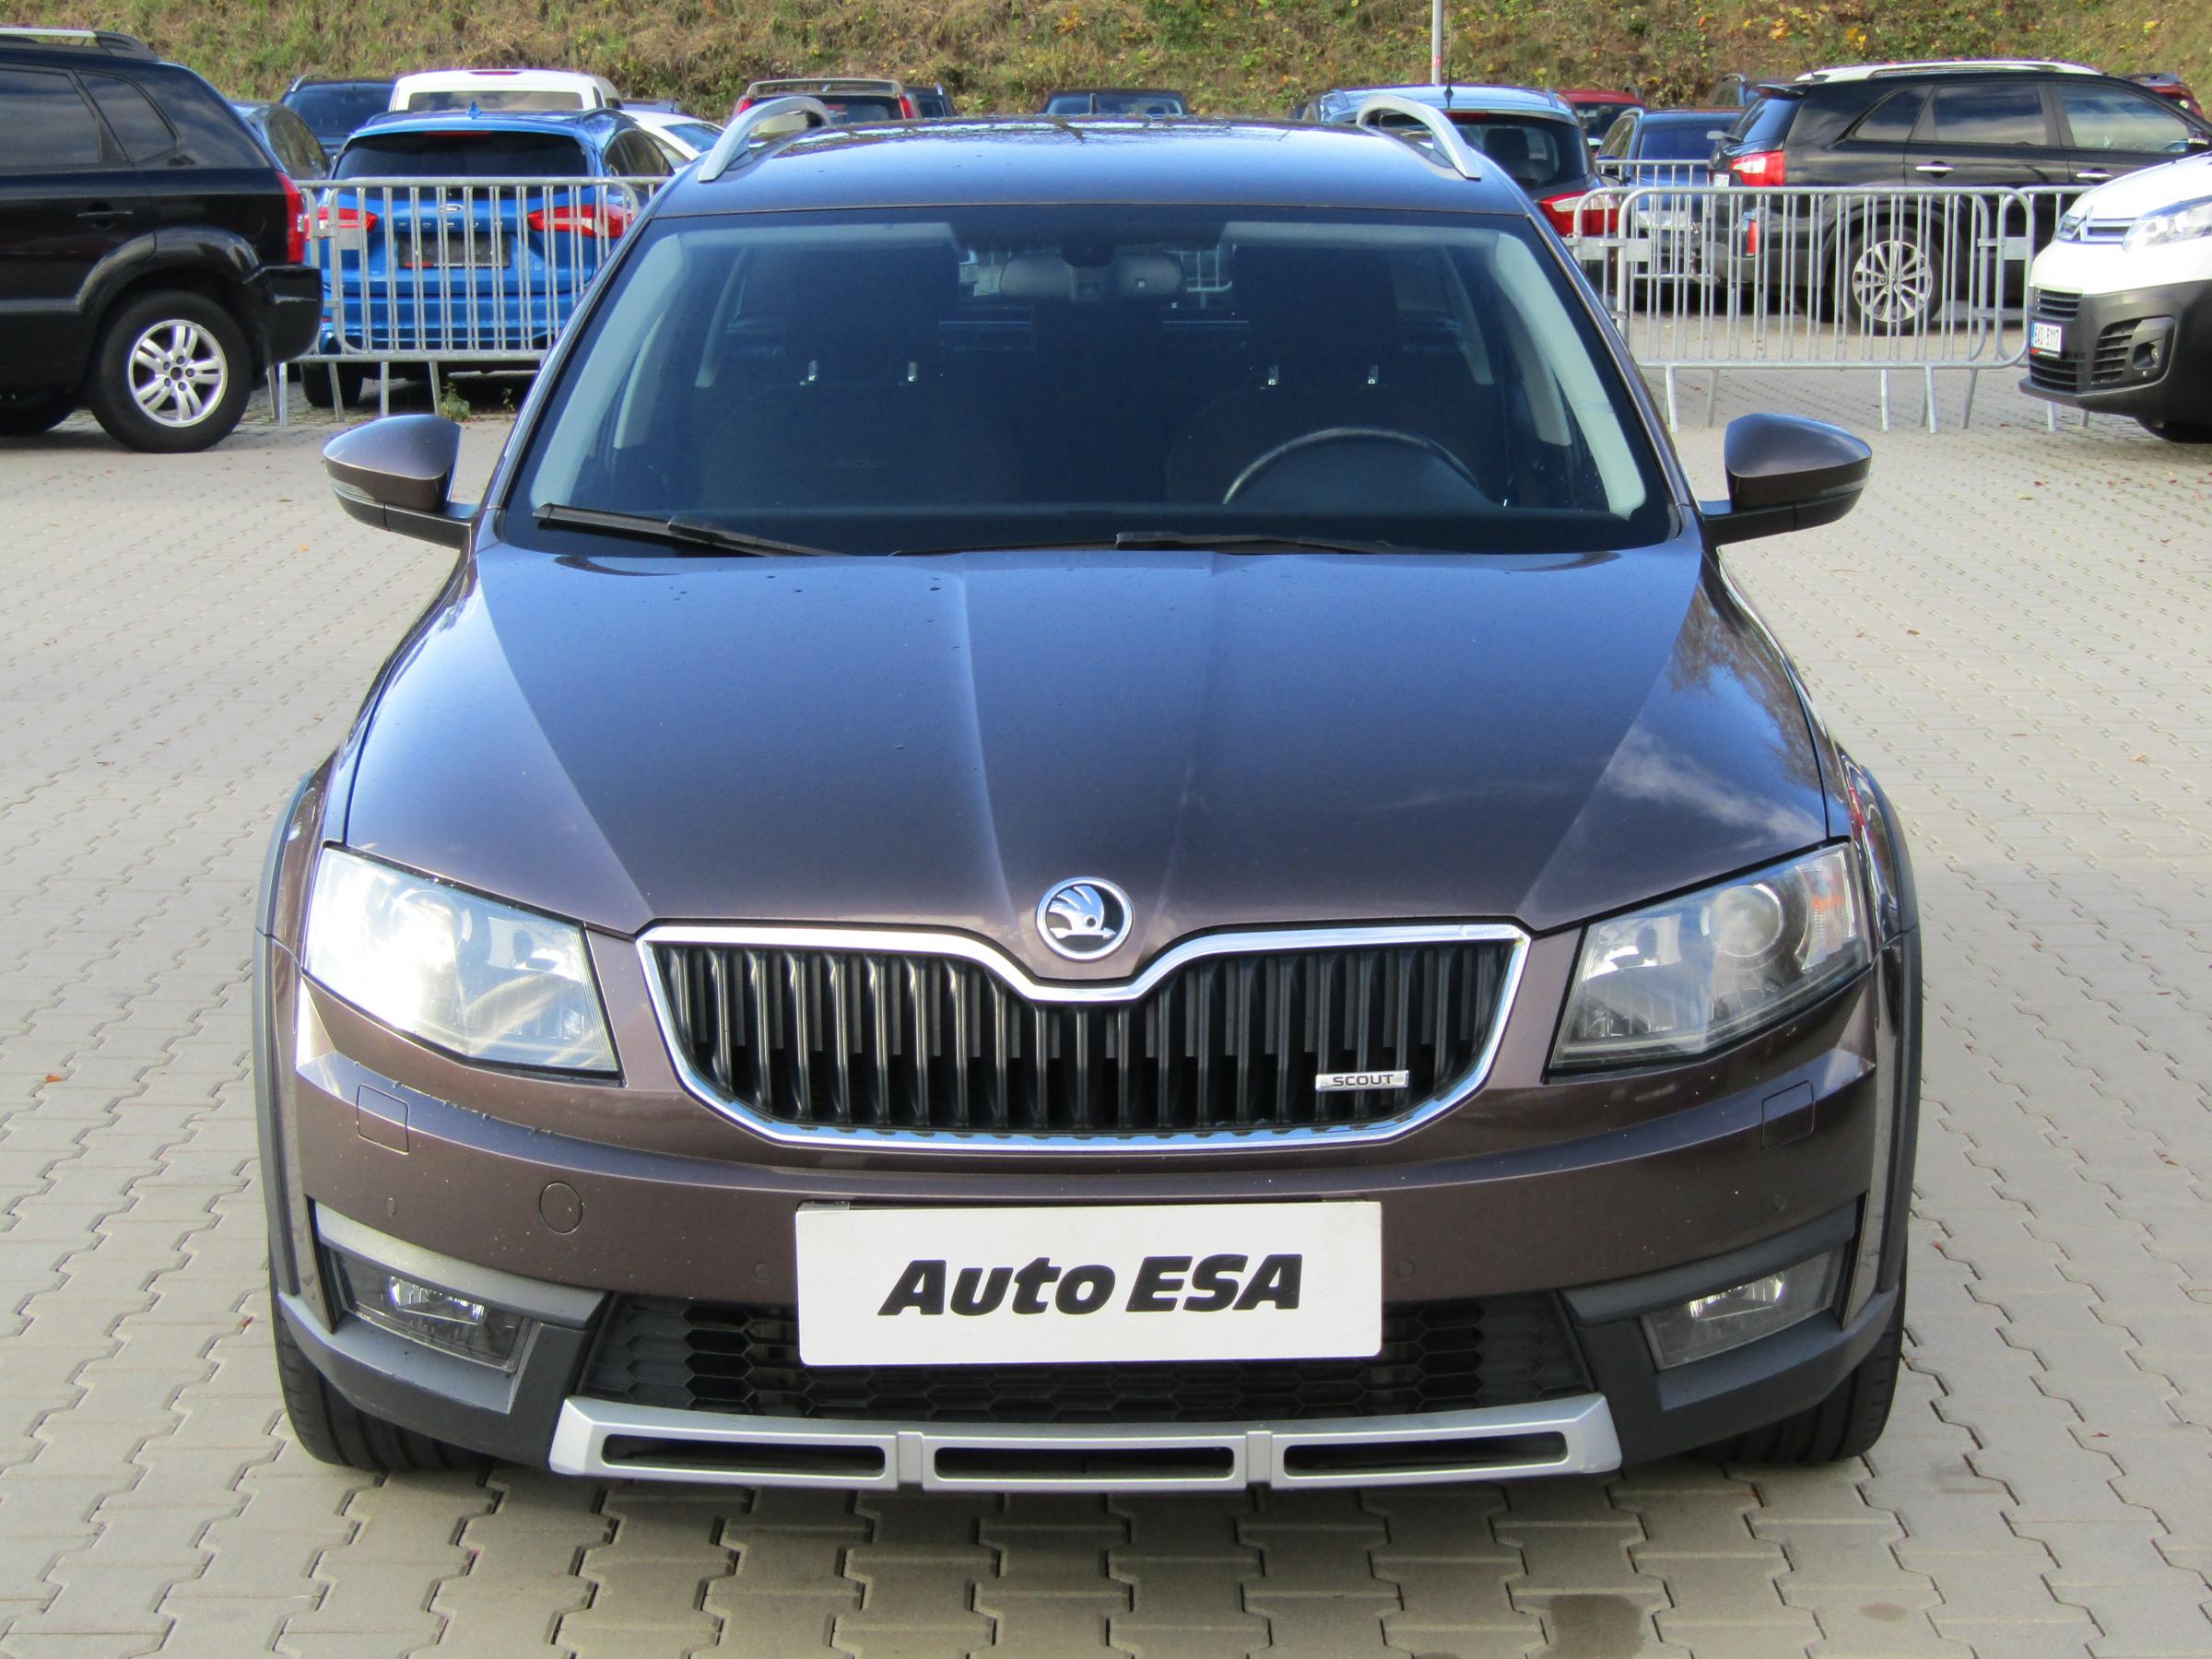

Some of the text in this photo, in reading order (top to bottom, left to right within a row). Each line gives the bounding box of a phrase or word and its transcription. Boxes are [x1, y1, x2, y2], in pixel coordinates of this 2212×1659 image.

[1333, 1075, 1394, 1087] SCOUT
[877, 1253, 1303, 1316] Auto ESA
